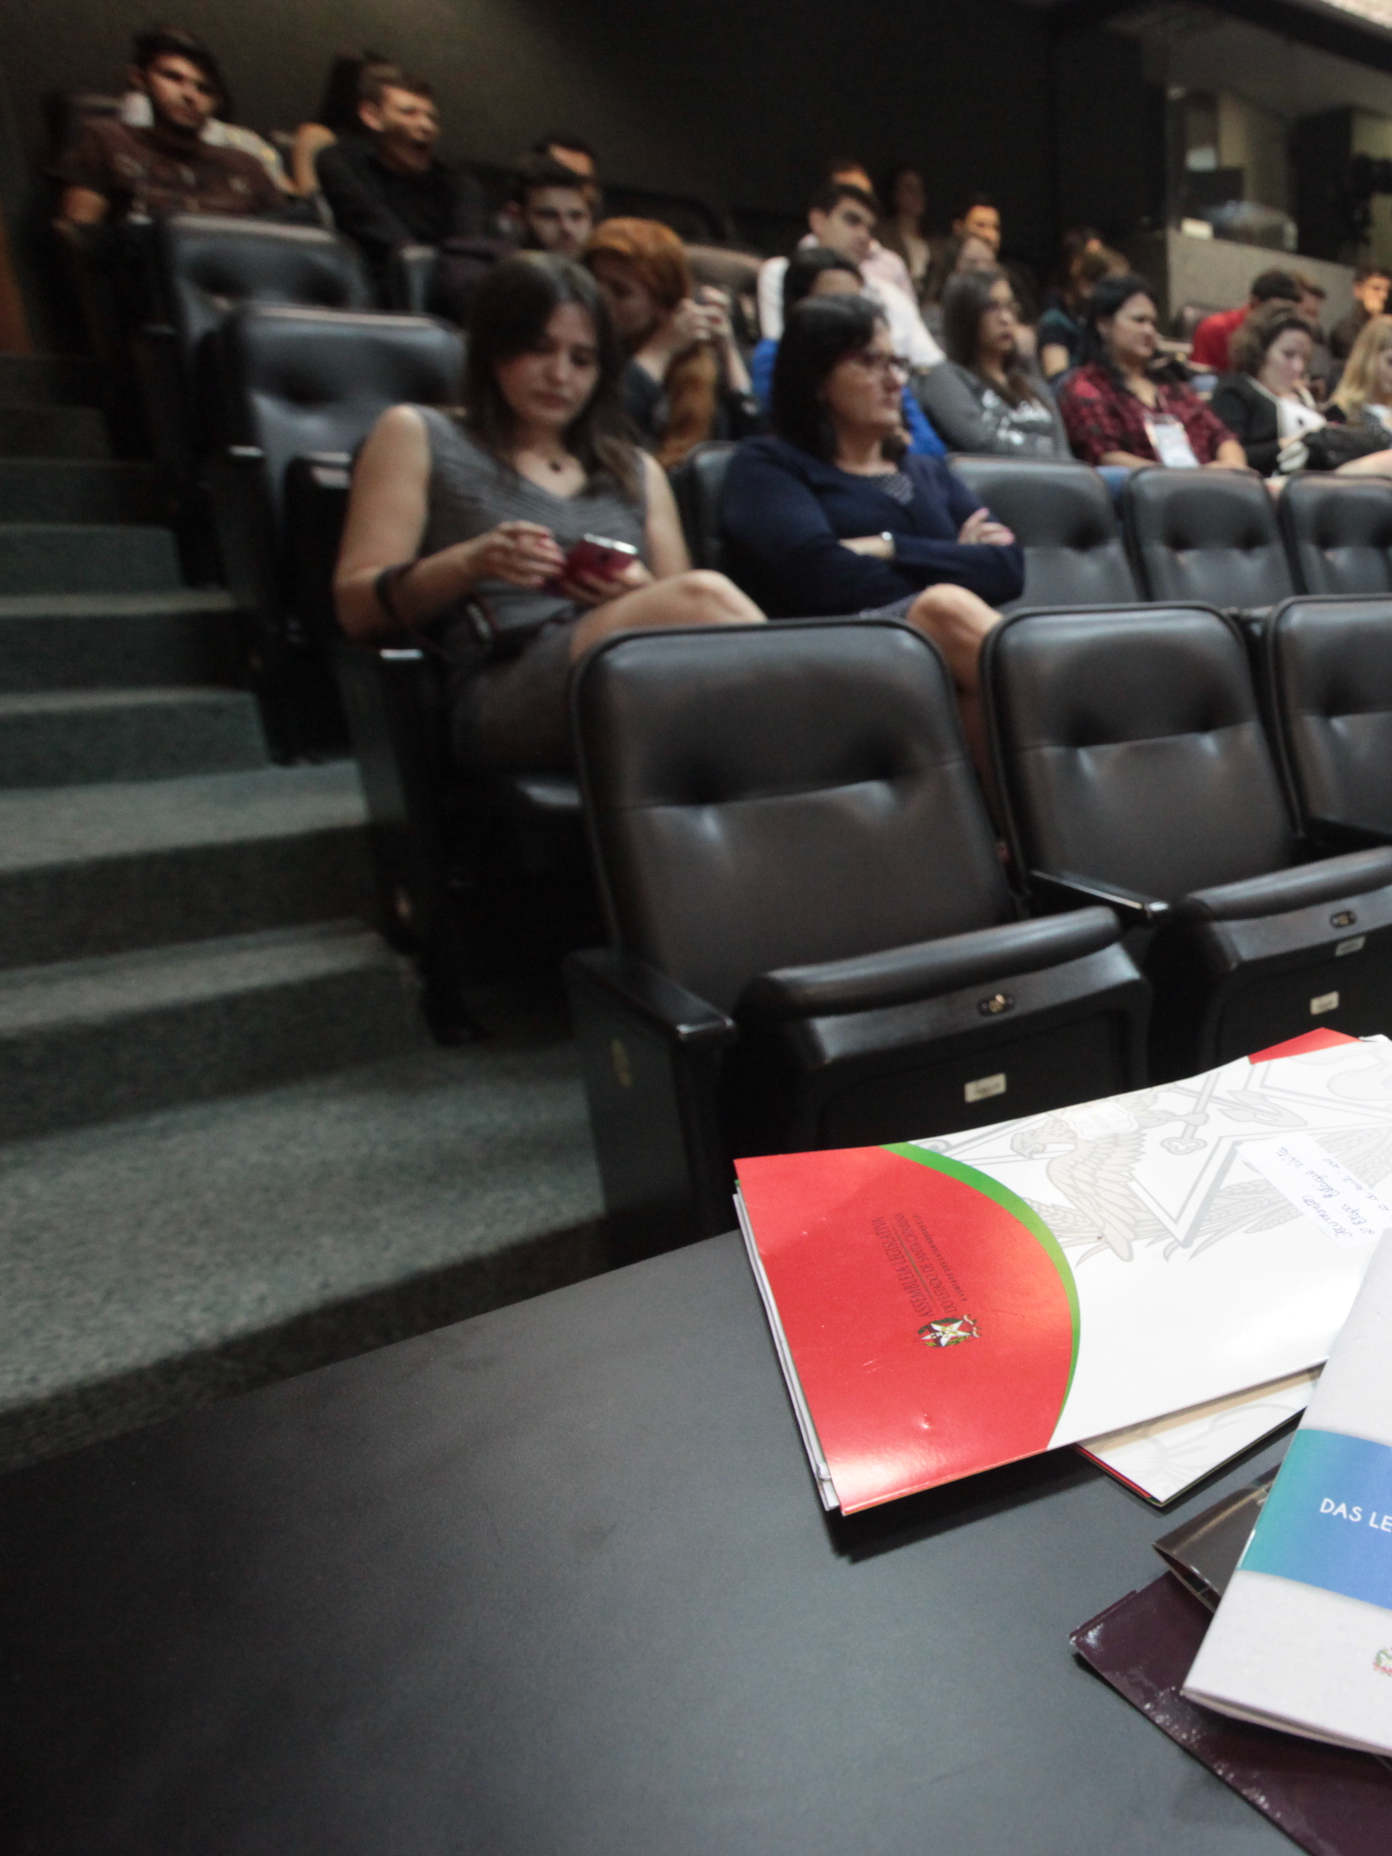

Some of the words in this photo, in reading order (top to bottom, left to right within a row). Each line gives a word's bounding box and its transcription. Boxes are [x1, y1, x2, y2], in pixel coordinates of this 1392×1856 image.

[871, 1217, 906, 1265] LEGISLATIVA
[921, 1263, 935, 1273] DE
[896, 1266, 935, 1317] ASSEMBLEIA
[940, 1300, 957, 1313] DO
[1319, 1497, 1362, 1522] DAS
